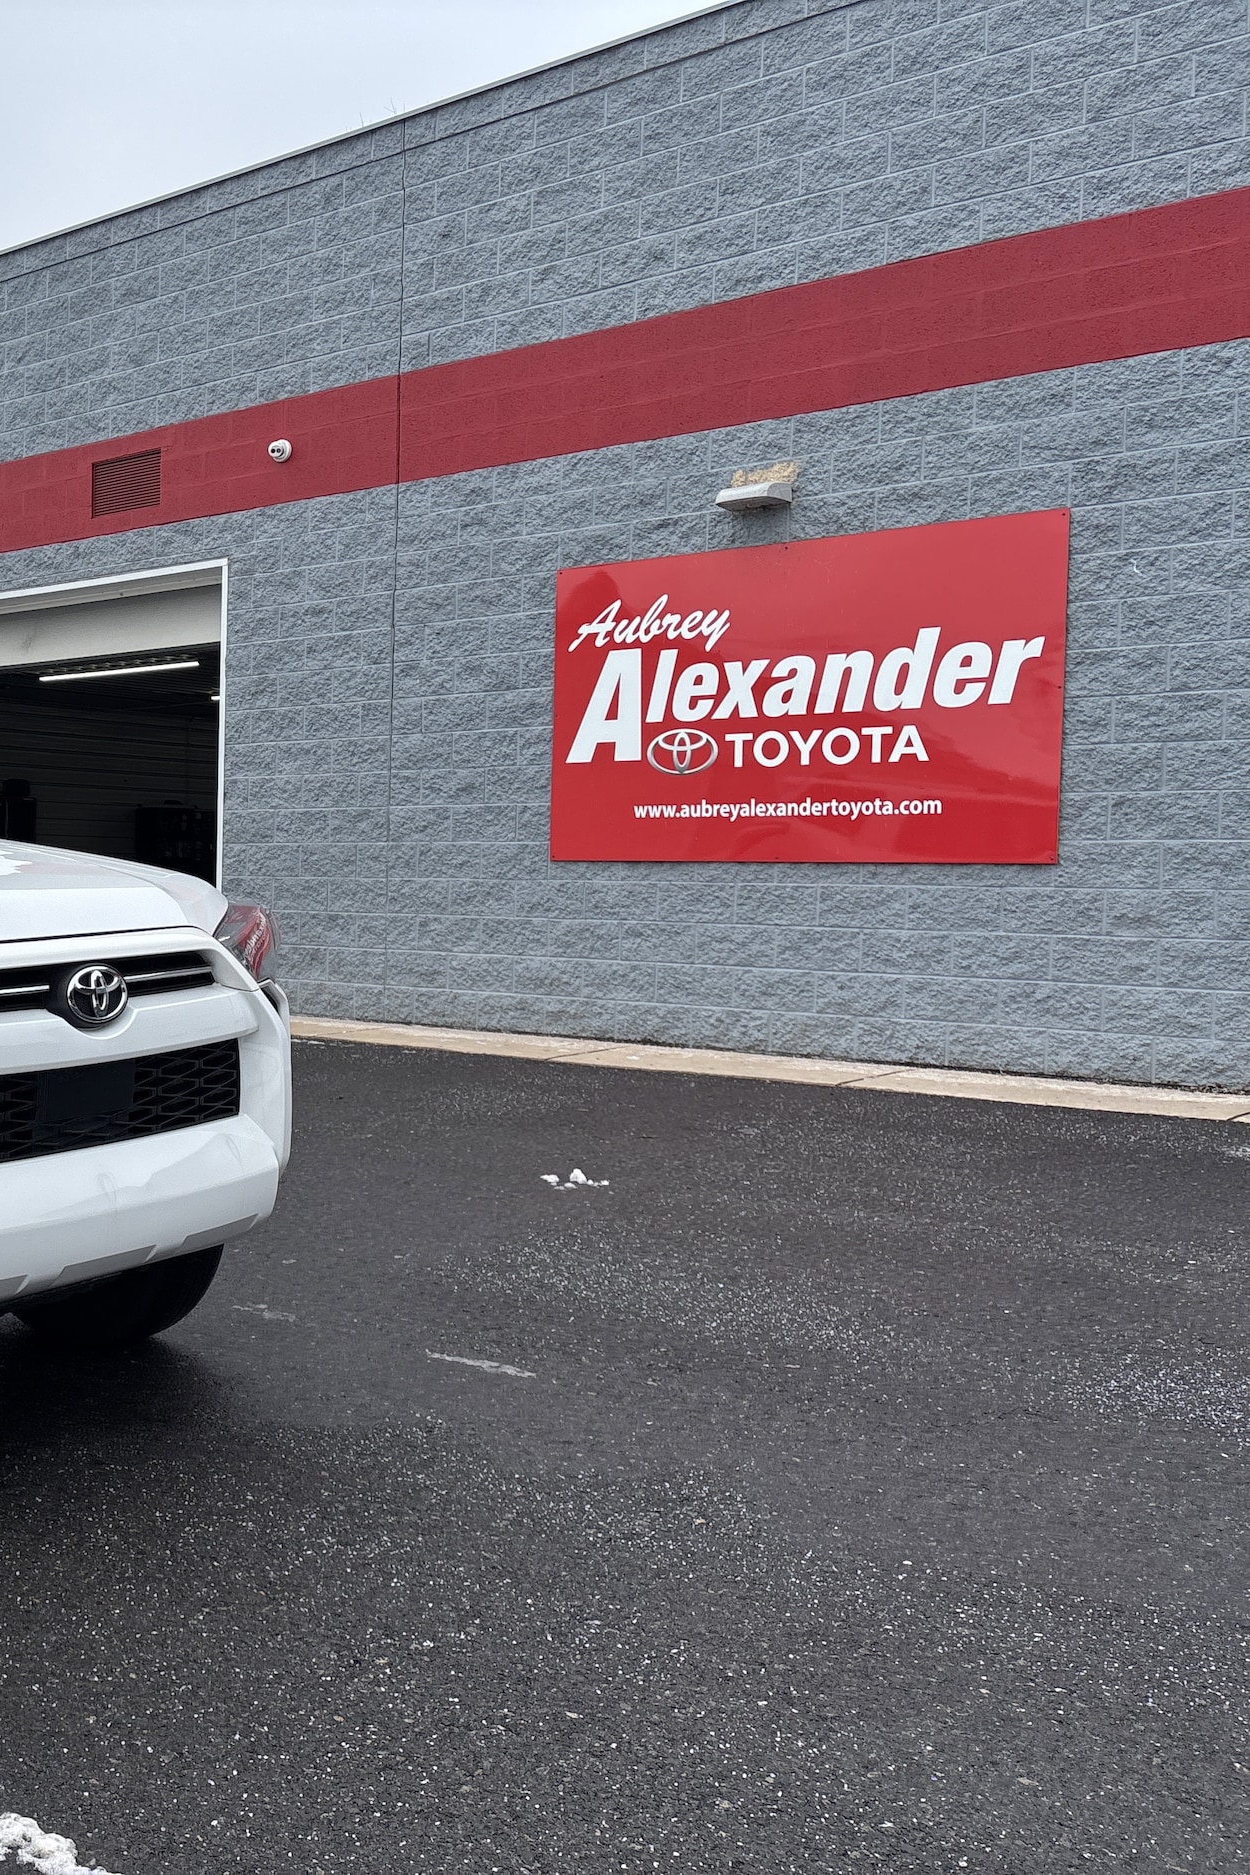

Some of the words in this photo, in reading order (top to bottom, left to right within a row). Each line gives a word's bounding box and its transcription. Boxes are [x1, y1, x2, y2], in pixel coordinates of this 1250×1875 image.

[568, 594, 731, 652] Aubrey
[565, 627, 1046, 764] Alexander
[724, 725, 931, 769] TOYOTA
[633, 798, 943, 822] www.aubreyalexandertoyota.com
